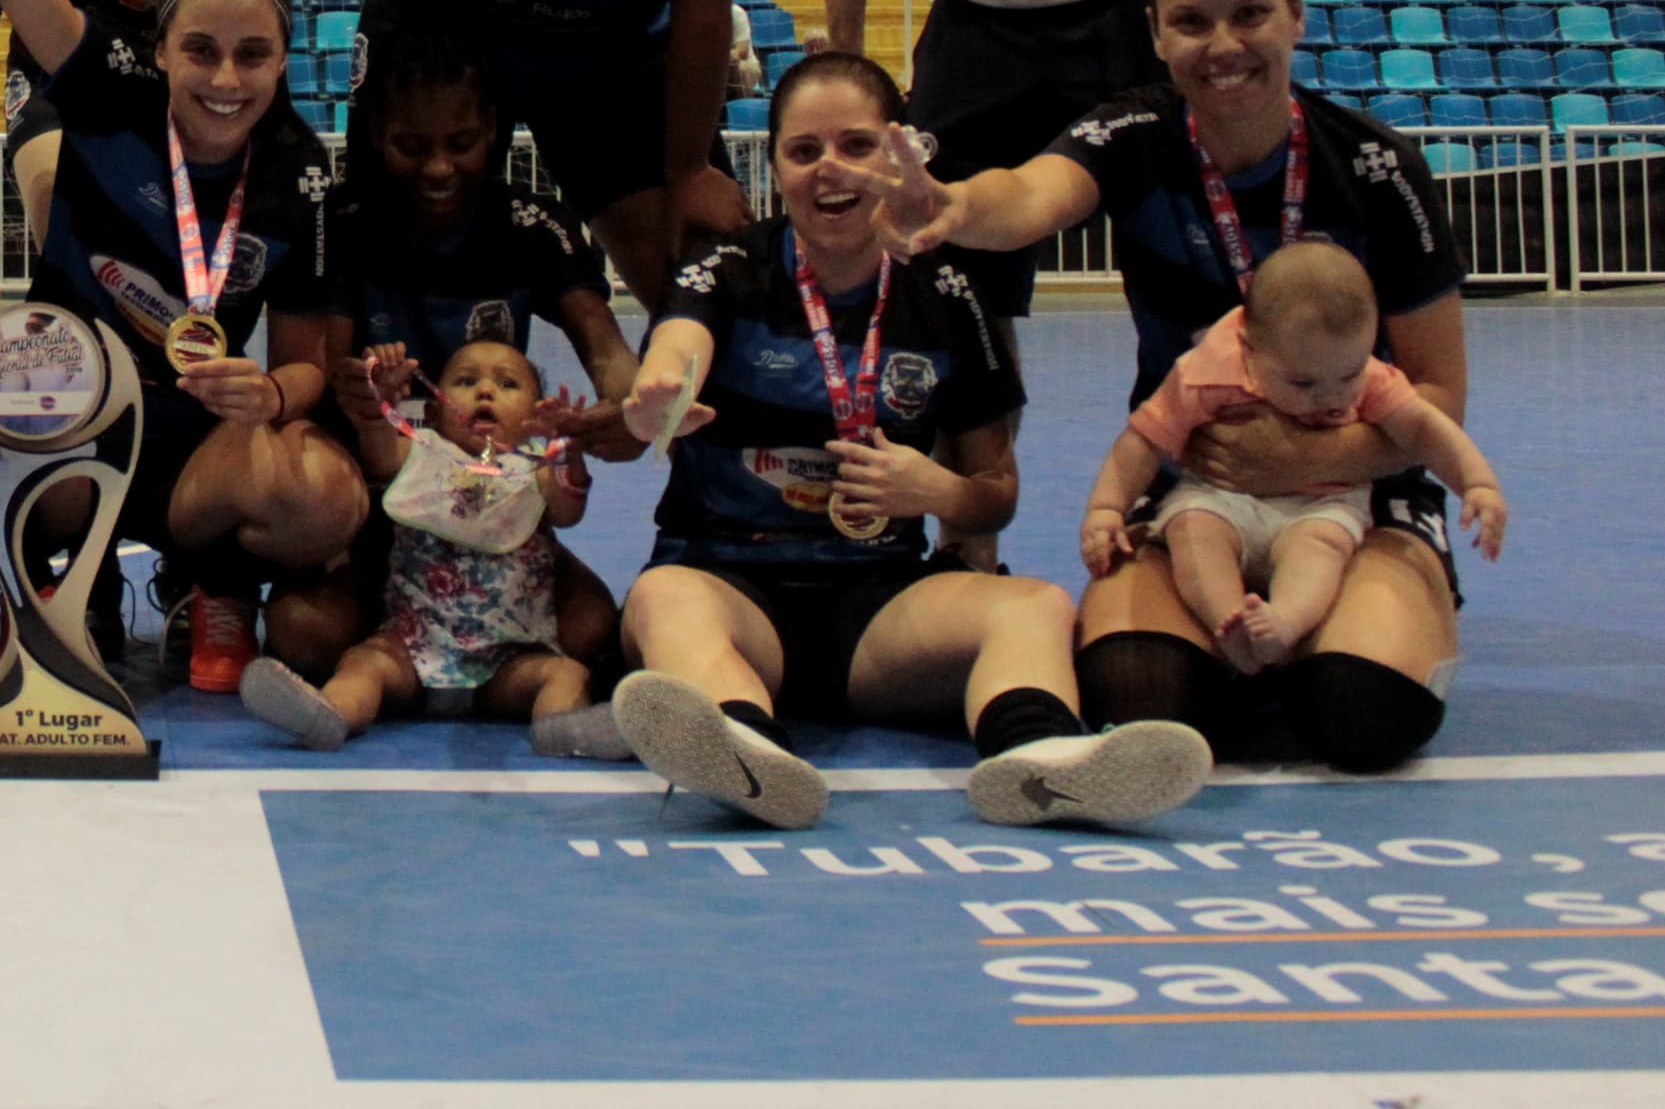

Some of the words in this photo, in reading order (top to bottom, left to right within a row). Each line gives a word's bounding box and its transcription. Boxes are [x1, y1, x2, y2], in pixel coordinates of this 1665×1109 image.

[38, 710, 104, 731] Lugar
[23, 733, 90, 746] ADULTO
[92, 733, 130, 746] FEM.
[961, 885, 1489, 934] mais
[981, 952, 1665, 1009] Santa
